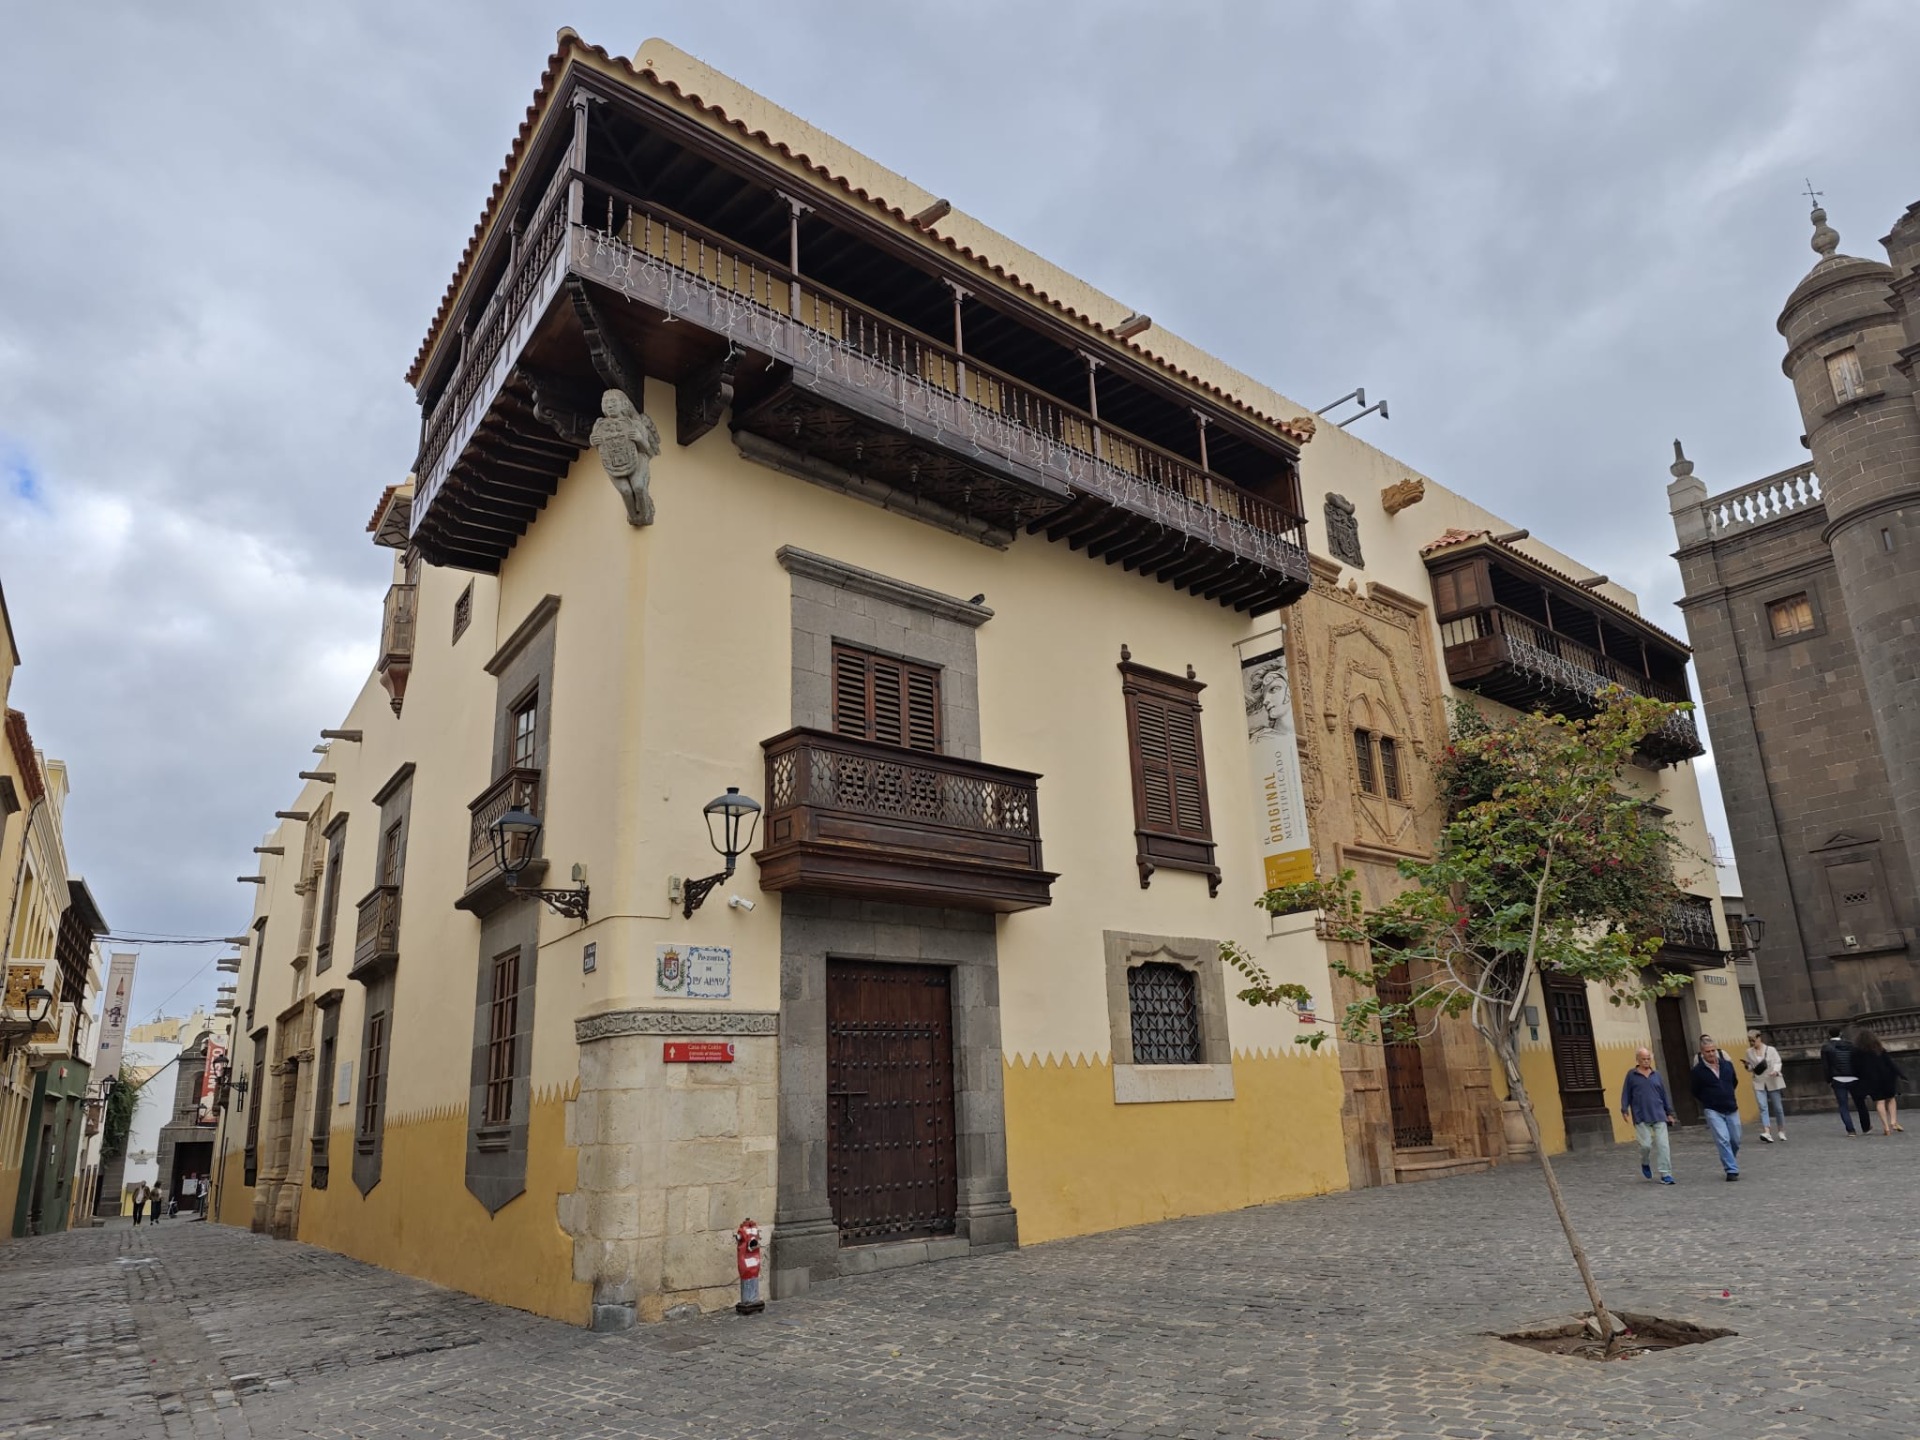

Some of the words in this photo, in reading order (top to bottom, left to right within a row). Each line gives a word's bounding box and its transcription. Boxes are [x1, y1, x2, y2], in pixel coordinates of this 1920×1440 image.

[1264, 772, 1284, 843] ORIGINAL
[1275, 751, 1293, 839] MULTIPLICADO
[1264, 836, 1271, 845] EL
